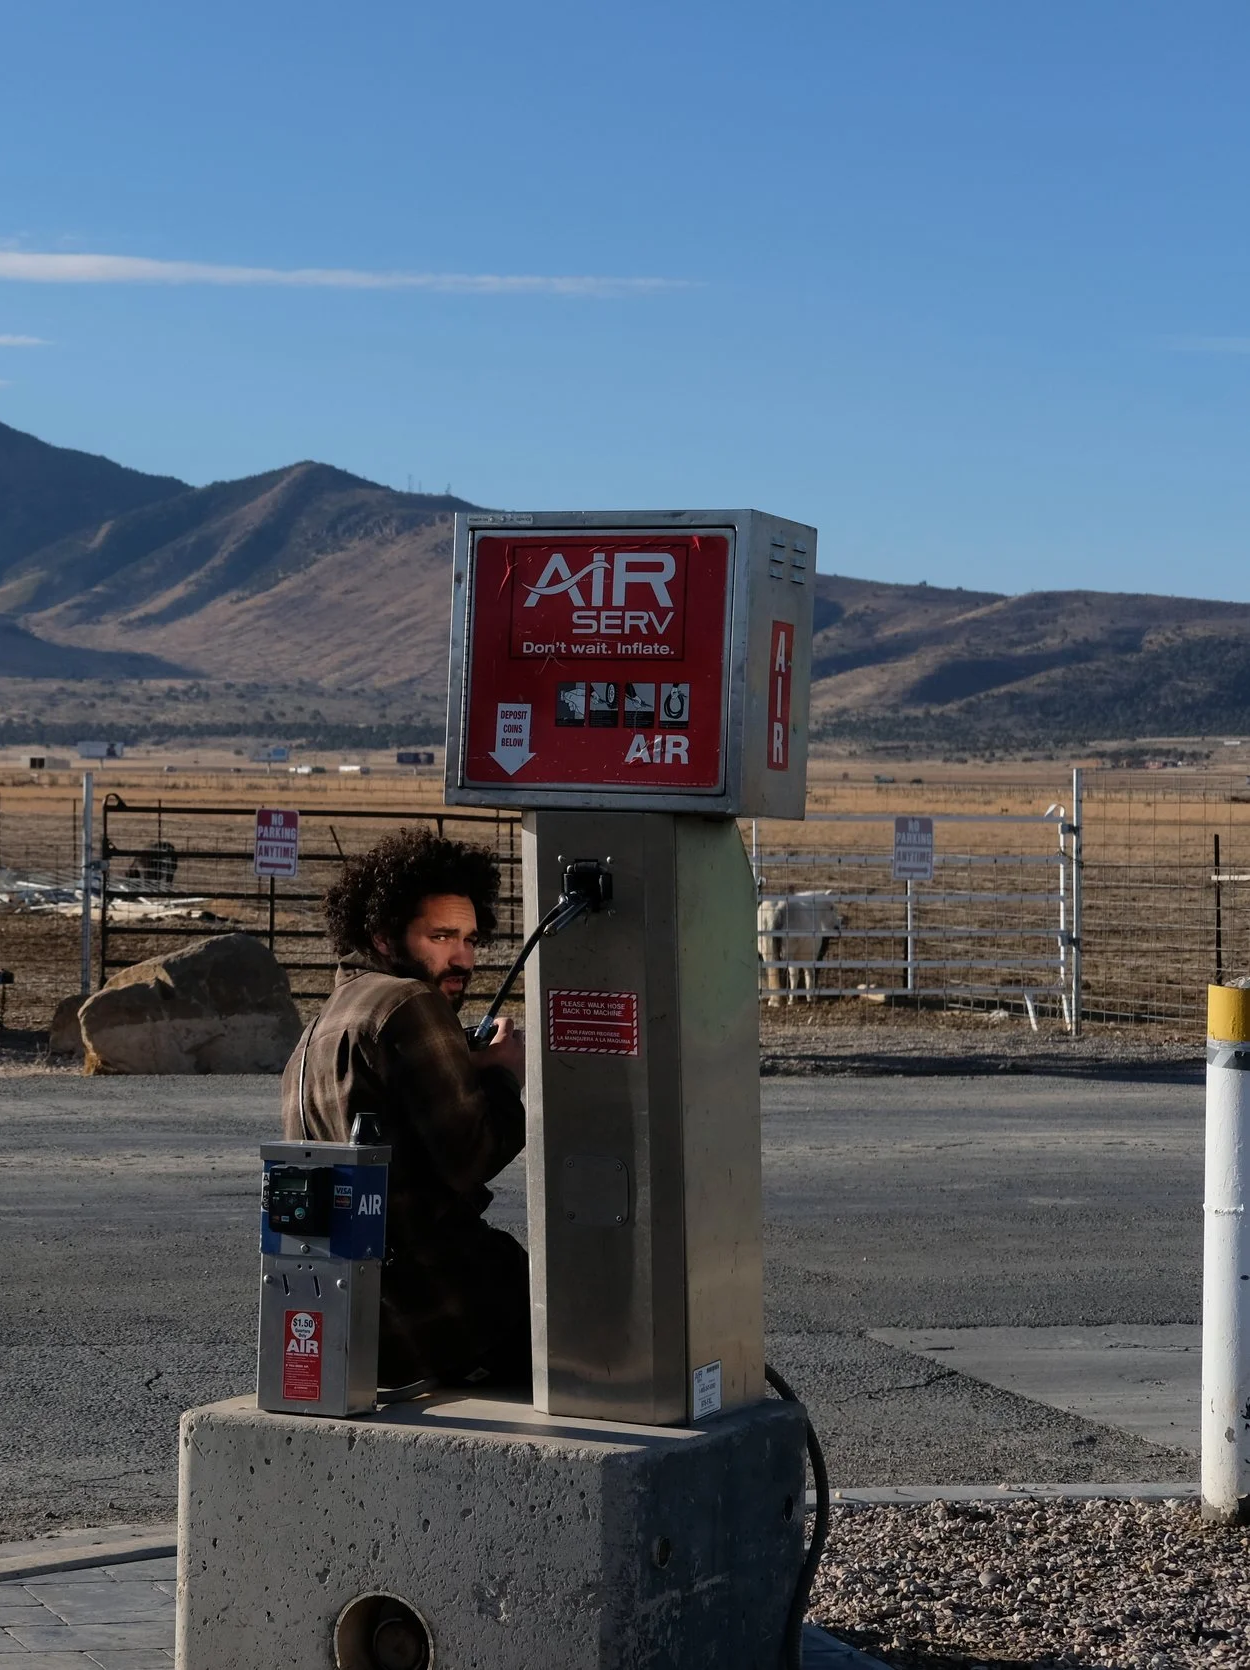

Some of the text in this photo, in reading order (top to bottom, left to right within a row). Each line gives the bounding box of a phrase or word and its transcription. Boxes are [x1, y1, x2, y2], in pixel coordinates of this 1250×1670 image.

[522, 553, 676, 607] AIR
[572, 611, 674, 634] SERV
[523, 642, 674, 655] Don't wait. Inflate.
[773, 631, 786, 764] AIR
[501, 710, 527, 720] DEPOSIT
[503, 724, 523, 733] COINS
[501, 738, 523, 747] BELOW
[624, 734, 689, 764] AIR
[271, 813, 284, 826] NO
[908, 820, 920, 832] NO
[258, 825, 296, 840] PARKING
[896, 832, 932, 845] PARKING
[258, 845, 295, 859] ANYTIME
[896, 851, 931, 863] ANYTIME
[336, 1187, 351, 1195] VISA
[358, 1194, 382, 1215] AIR
[293, 1318, 313, 1328] $1.50
[286, 1339, 319, 1353] AIR
